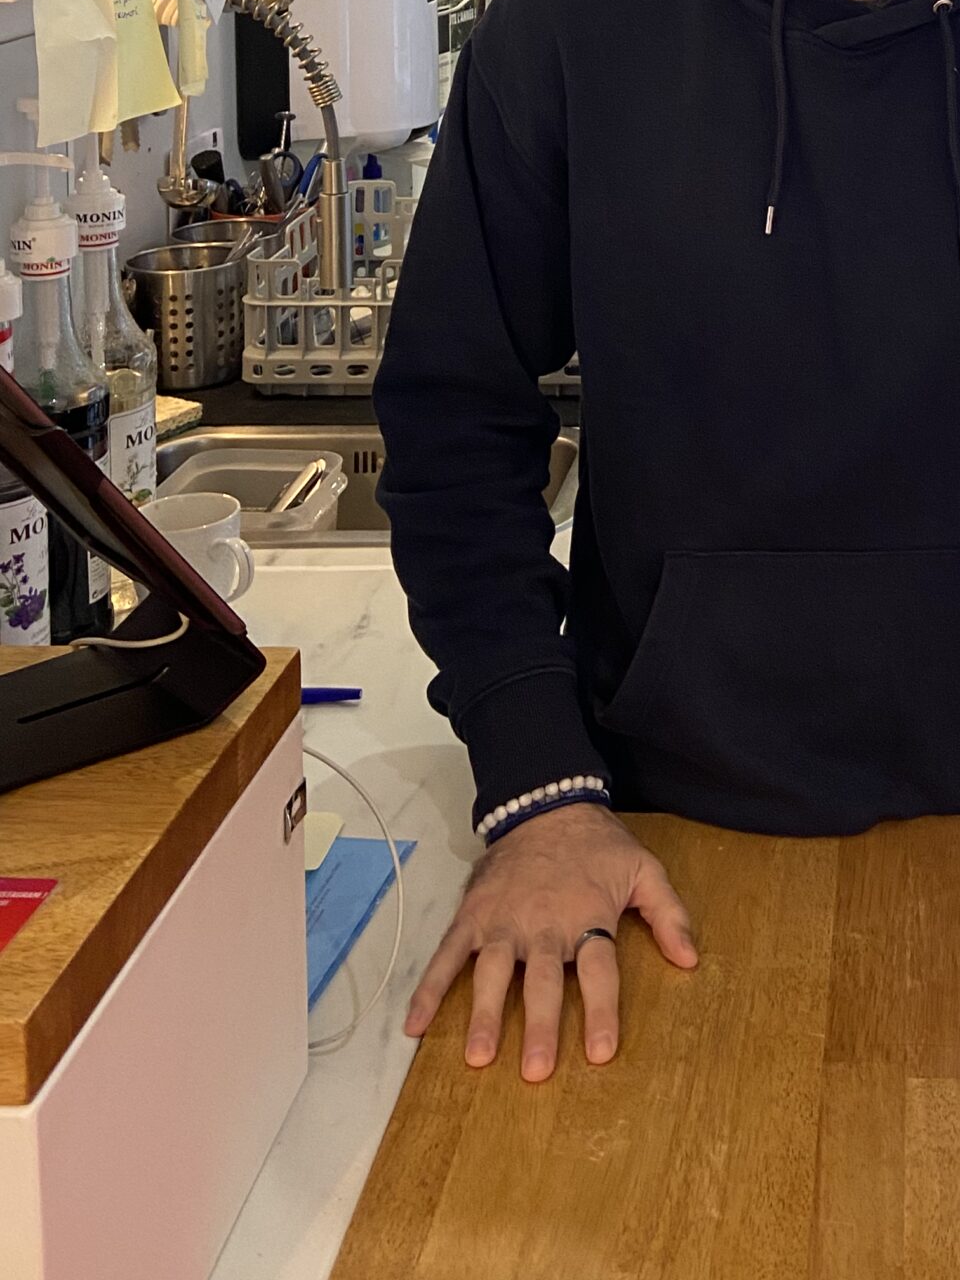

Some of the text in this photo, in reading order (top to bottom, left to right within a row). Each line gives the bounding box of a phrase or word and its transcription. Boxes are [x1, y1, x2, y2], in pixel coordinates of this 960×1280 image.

[76, 209, 125, 223] MONIN
[80, 231, 117, 242] MONIN
[23, 261, 62, 271] MONIN
